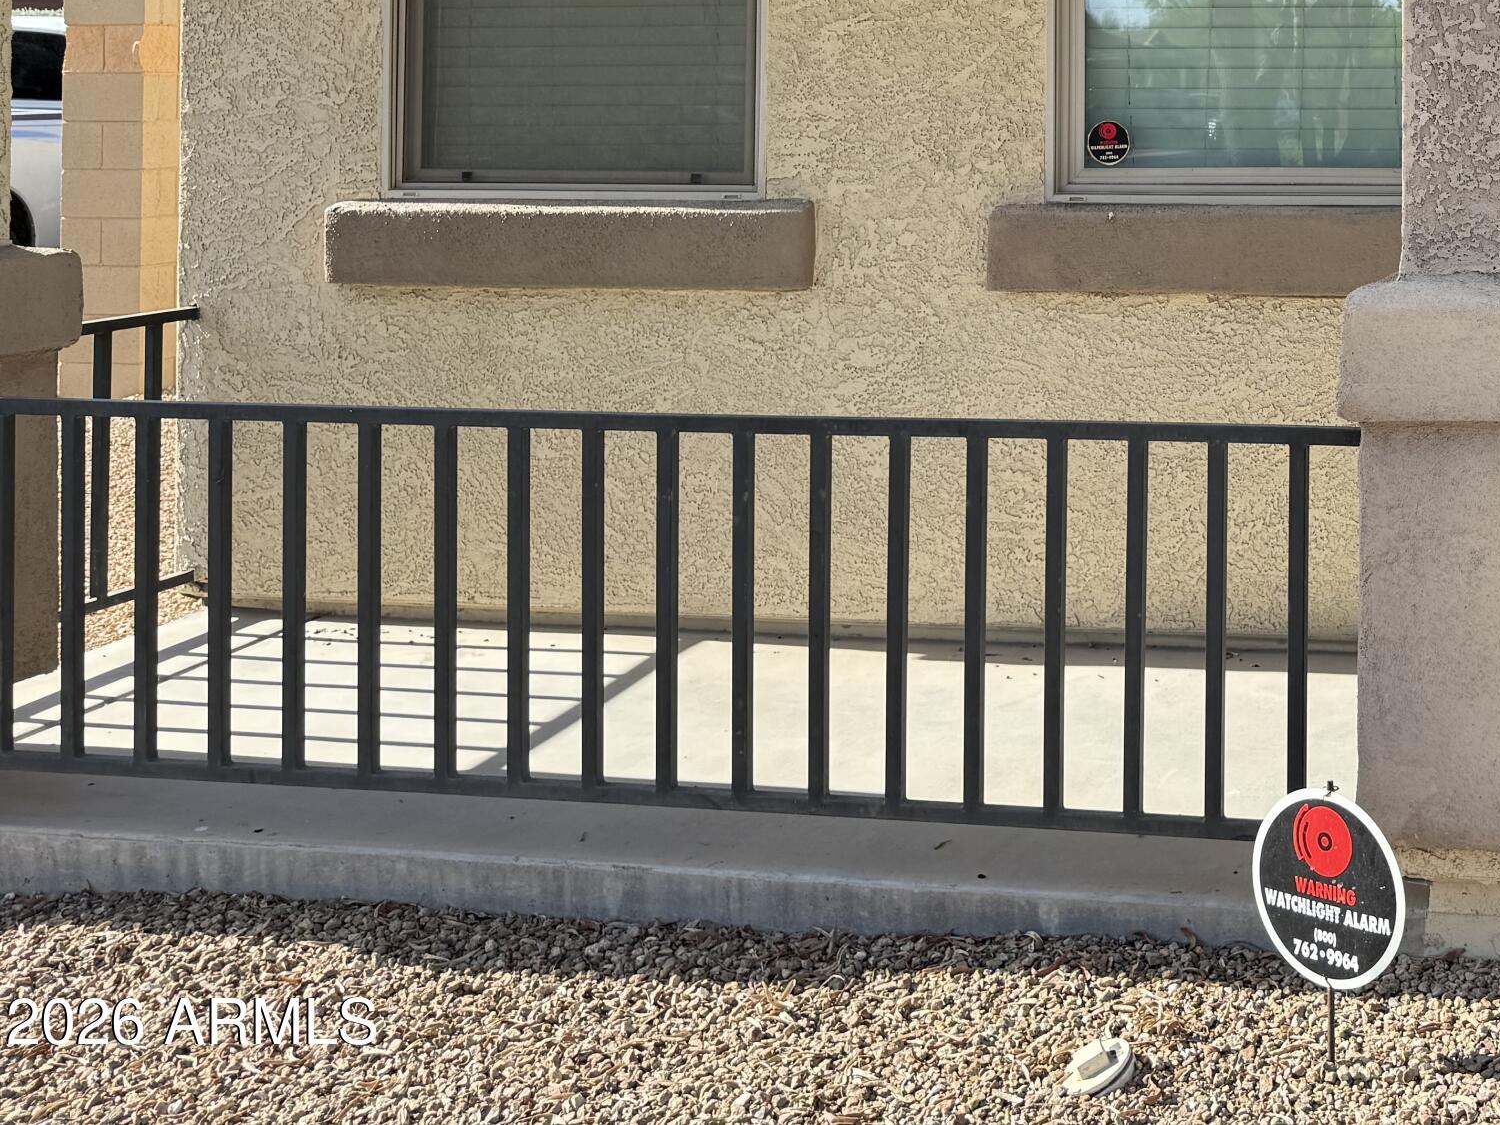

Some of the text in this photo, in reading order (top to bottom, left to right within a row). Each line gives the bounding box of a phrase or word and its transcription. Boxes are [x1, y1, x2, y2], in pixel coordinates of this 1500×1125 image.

[1294, 876, 1356, 906] WARNING
[1264, 888, 1390, 936] WATCHLIGHT ALARM
[1313, 928, 1337, 947] (800)
